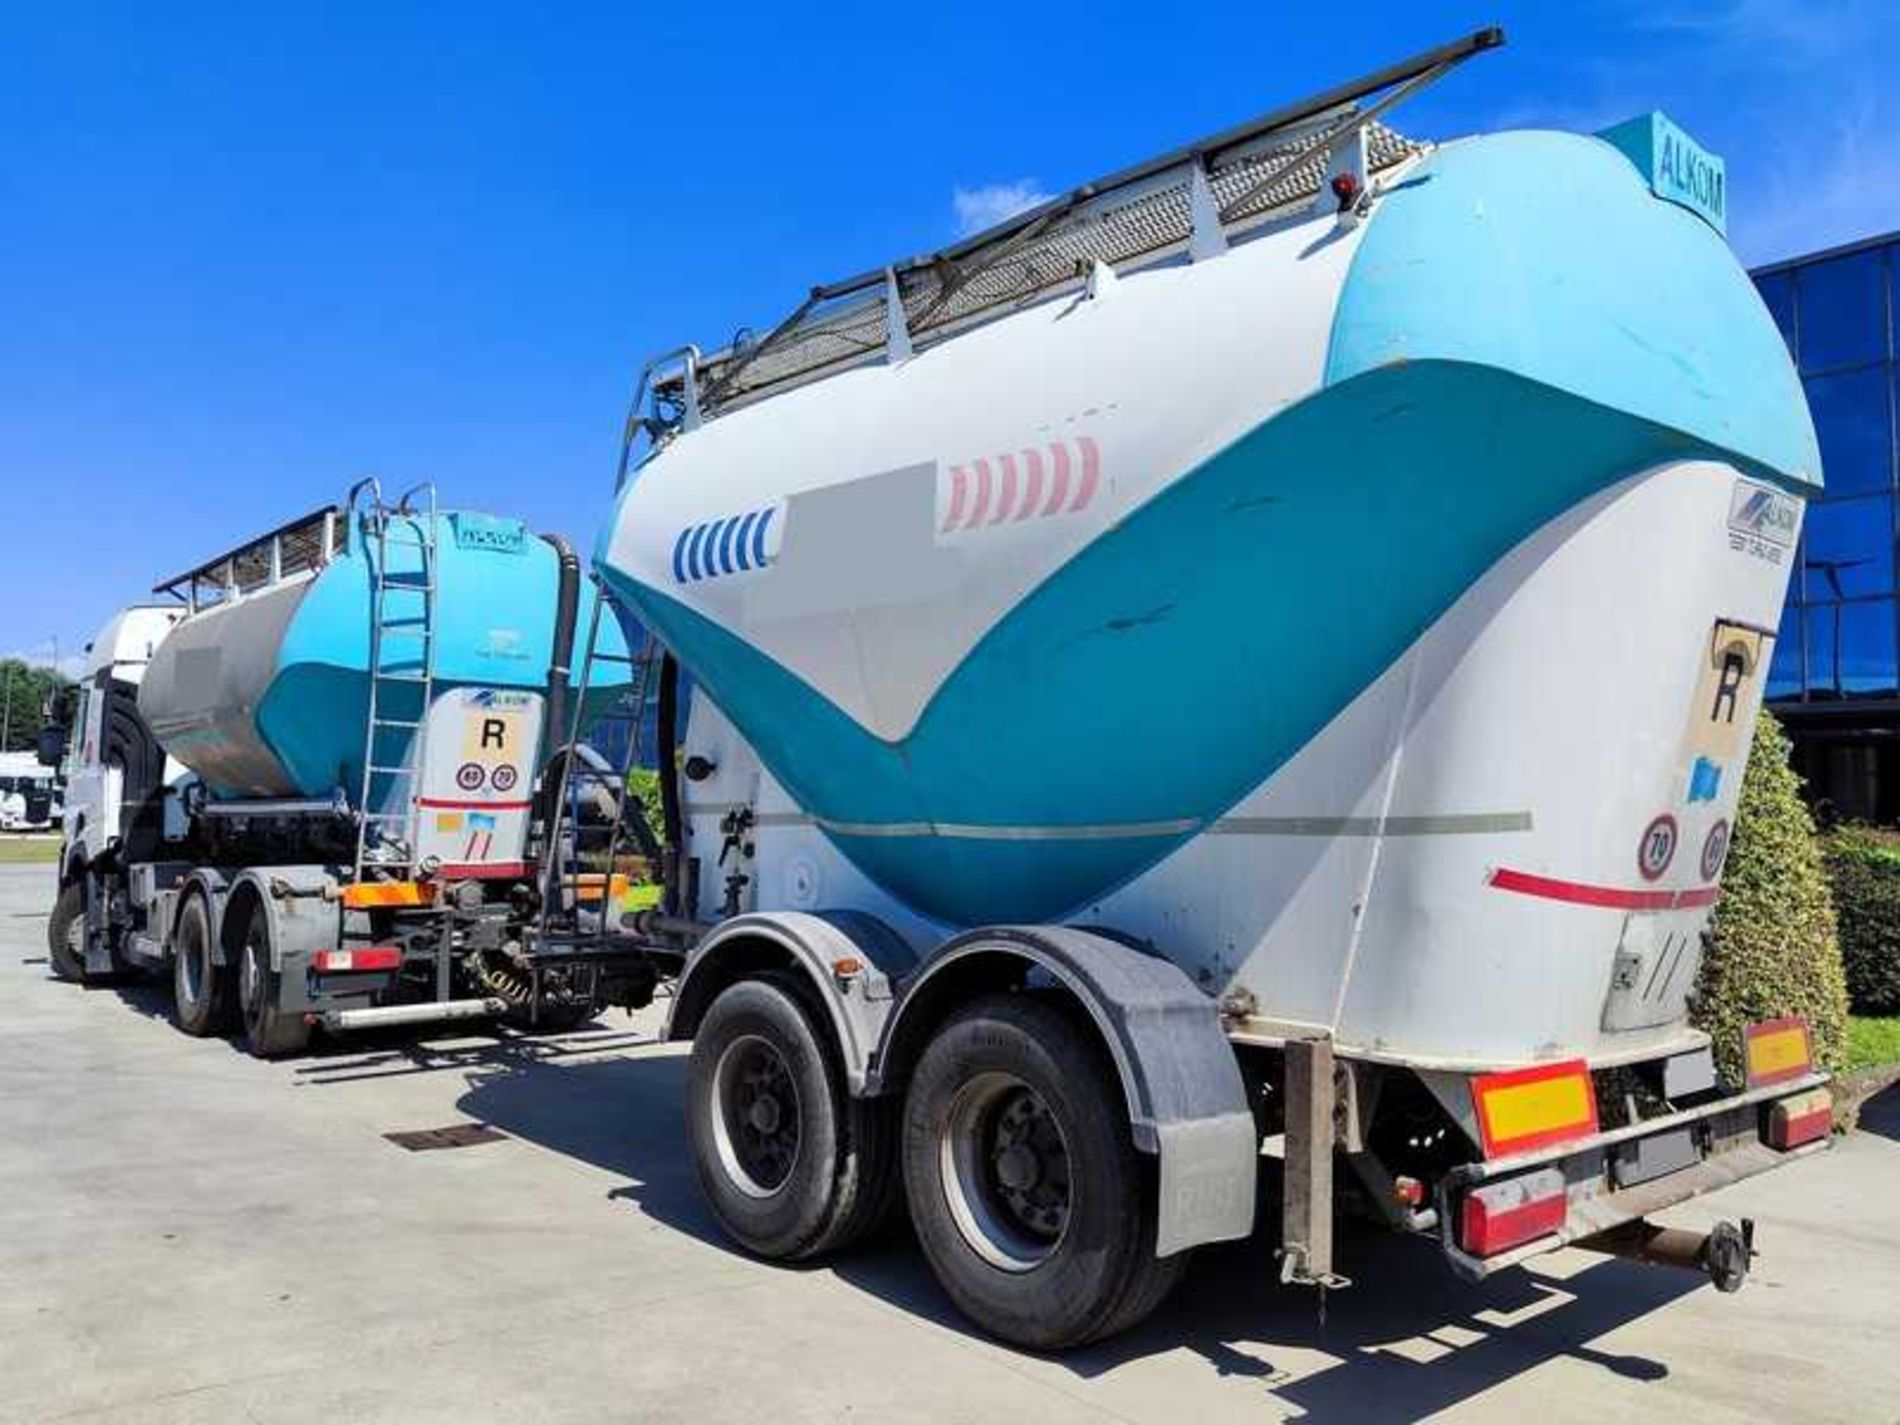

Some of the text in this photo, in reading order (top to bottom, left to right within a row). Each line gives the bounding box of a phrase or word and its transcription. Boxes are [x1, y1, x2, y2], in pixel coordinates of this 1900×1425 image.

[1661, 132, 1723, 218] ALKOM
[1711, 652, 1743, 722] R
[482, 719, 505, 750] R
[1650, 831, 1670, 859] 70
